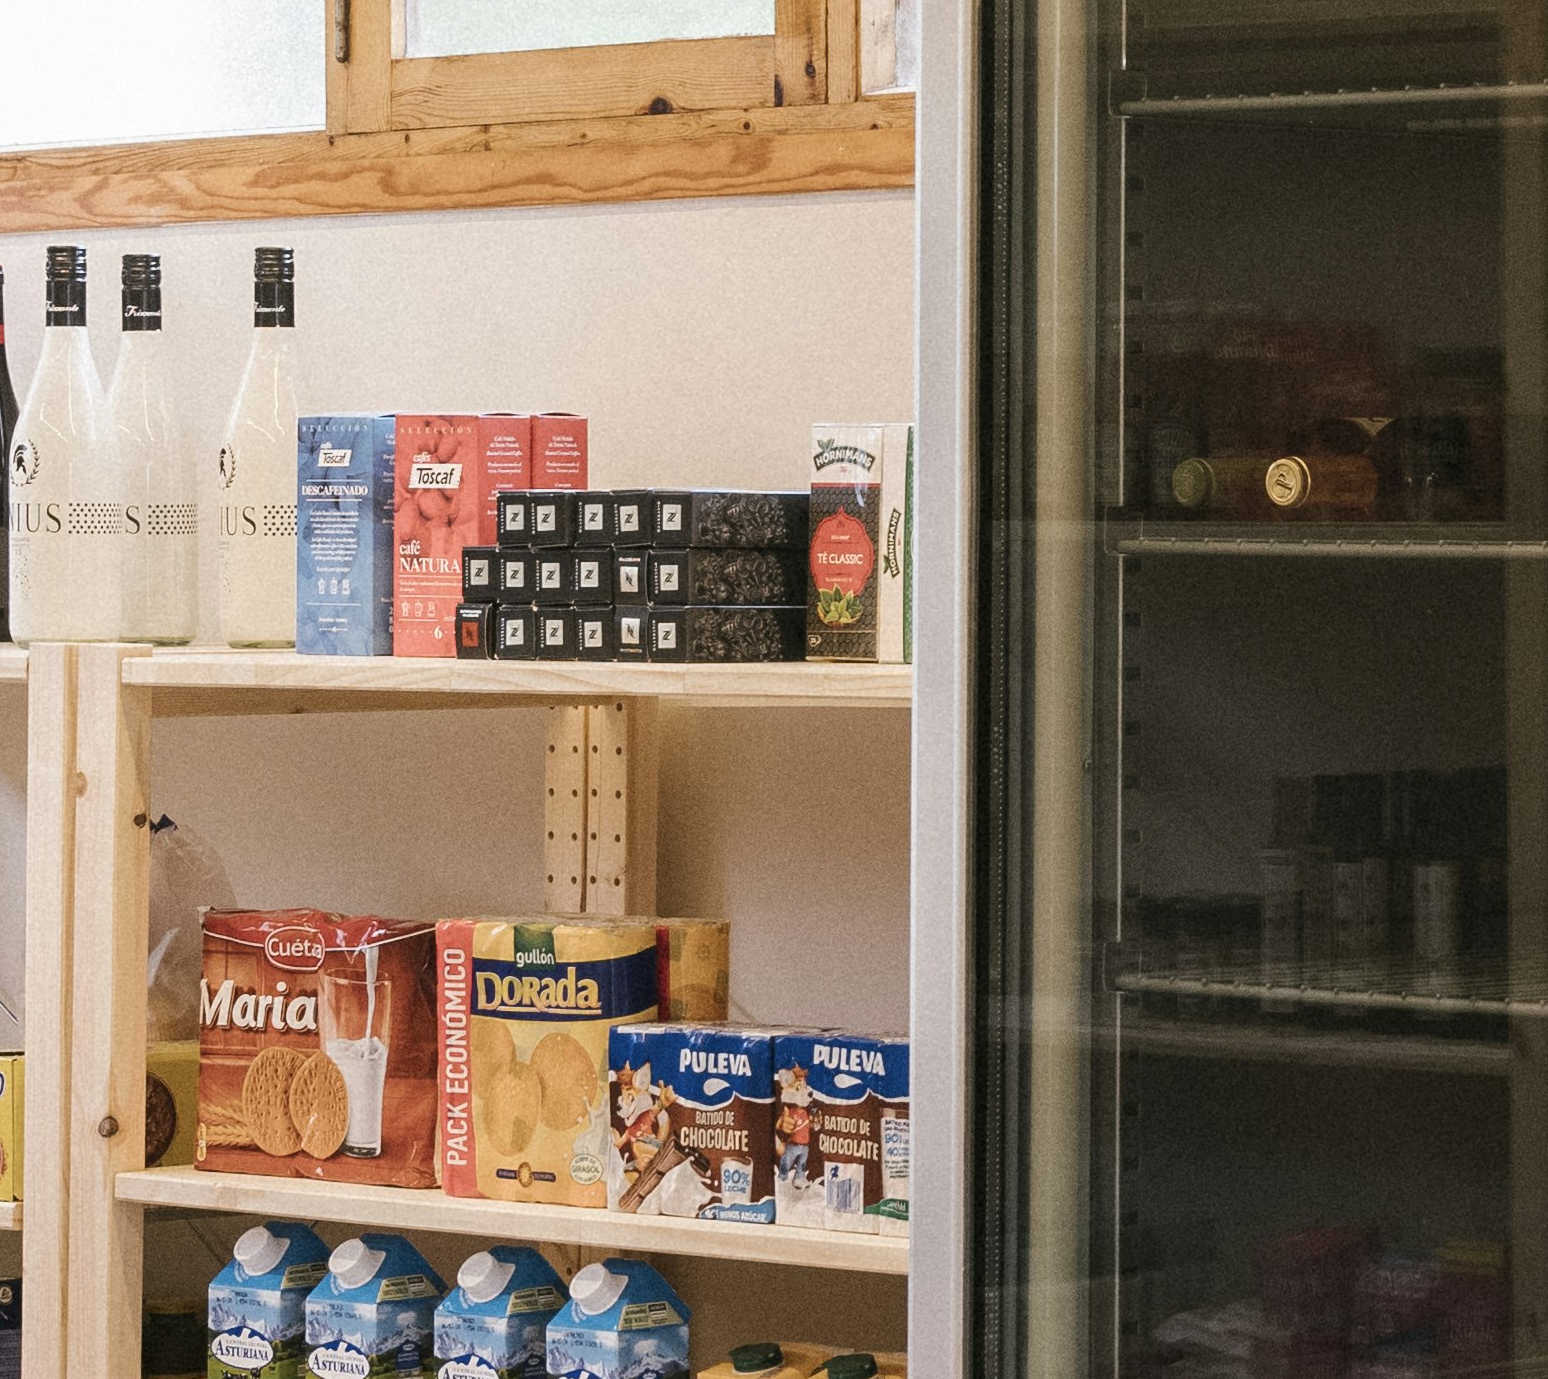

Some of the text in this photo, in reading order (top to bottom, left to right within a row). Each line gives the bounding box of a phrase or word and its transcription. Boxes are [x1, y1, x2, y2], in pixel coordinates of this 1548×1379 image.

[322, 452, 347, 464] Toscaf
[815, 447, 875, 470] HORNIMANS
[416, 467, 455, 485] Toscaf
[301, 485, 369, 496] DESCAFEINADO
[12, 502, 62, 534] IUS
[220, 505, 257, 536] IUS
[399, 540, 421, 555] café
[885, 509, 901, 577] HORNIMANS
[399, 558, 461, 573] NATURA
[817, 552, 864, 565] TÉ CLASSIC
[434, 625, 443, 639] 6
[516, 947, 555, 968] gullón
[199, 978, 318, 1031] Maria
[442, 947, 469, 1166] PACK ECONÓMICO
[679, 1048, 752, 1077] PULEVA
[813, 1044, 886, 1076] PULEVA
[695, 1111, 735, 1127] BATIDO DE
[824, 1115, 870, 1135] BATIDO DE
[680, 1126, 749, 1152] CHOCOLATE
[819, 1133, 879, 1161] CHOCOLATE
[723, 1168, 750, 1186] 90%
[724, 1185, 747, 1194] LECHE
[214, 1342, 270, 1362] ASTURIANA
[311, 1355, 366, 1377] ASTURIANA
